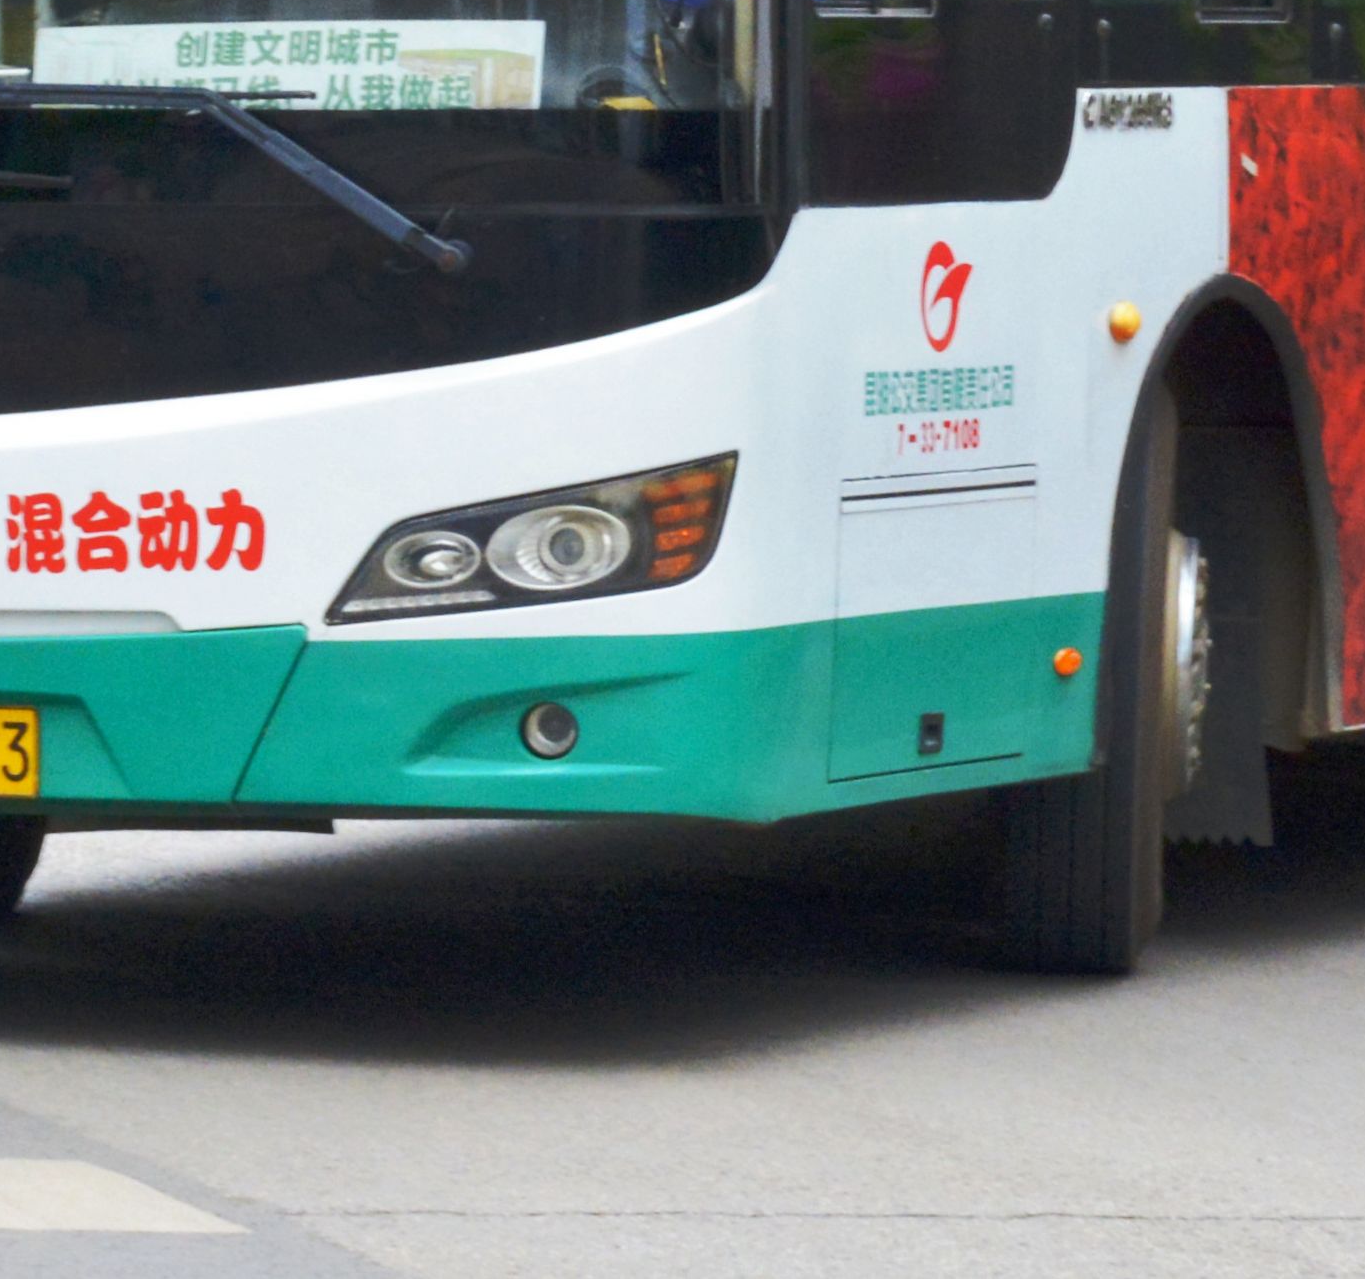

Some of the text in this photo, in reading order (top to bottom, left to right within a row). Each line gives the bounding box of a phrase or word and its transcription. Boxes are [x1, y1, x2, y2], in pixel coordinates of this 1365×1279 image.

[175, 29, 399, 67] 创建文明城市
[6, 488, 265, 573] 混合动力
